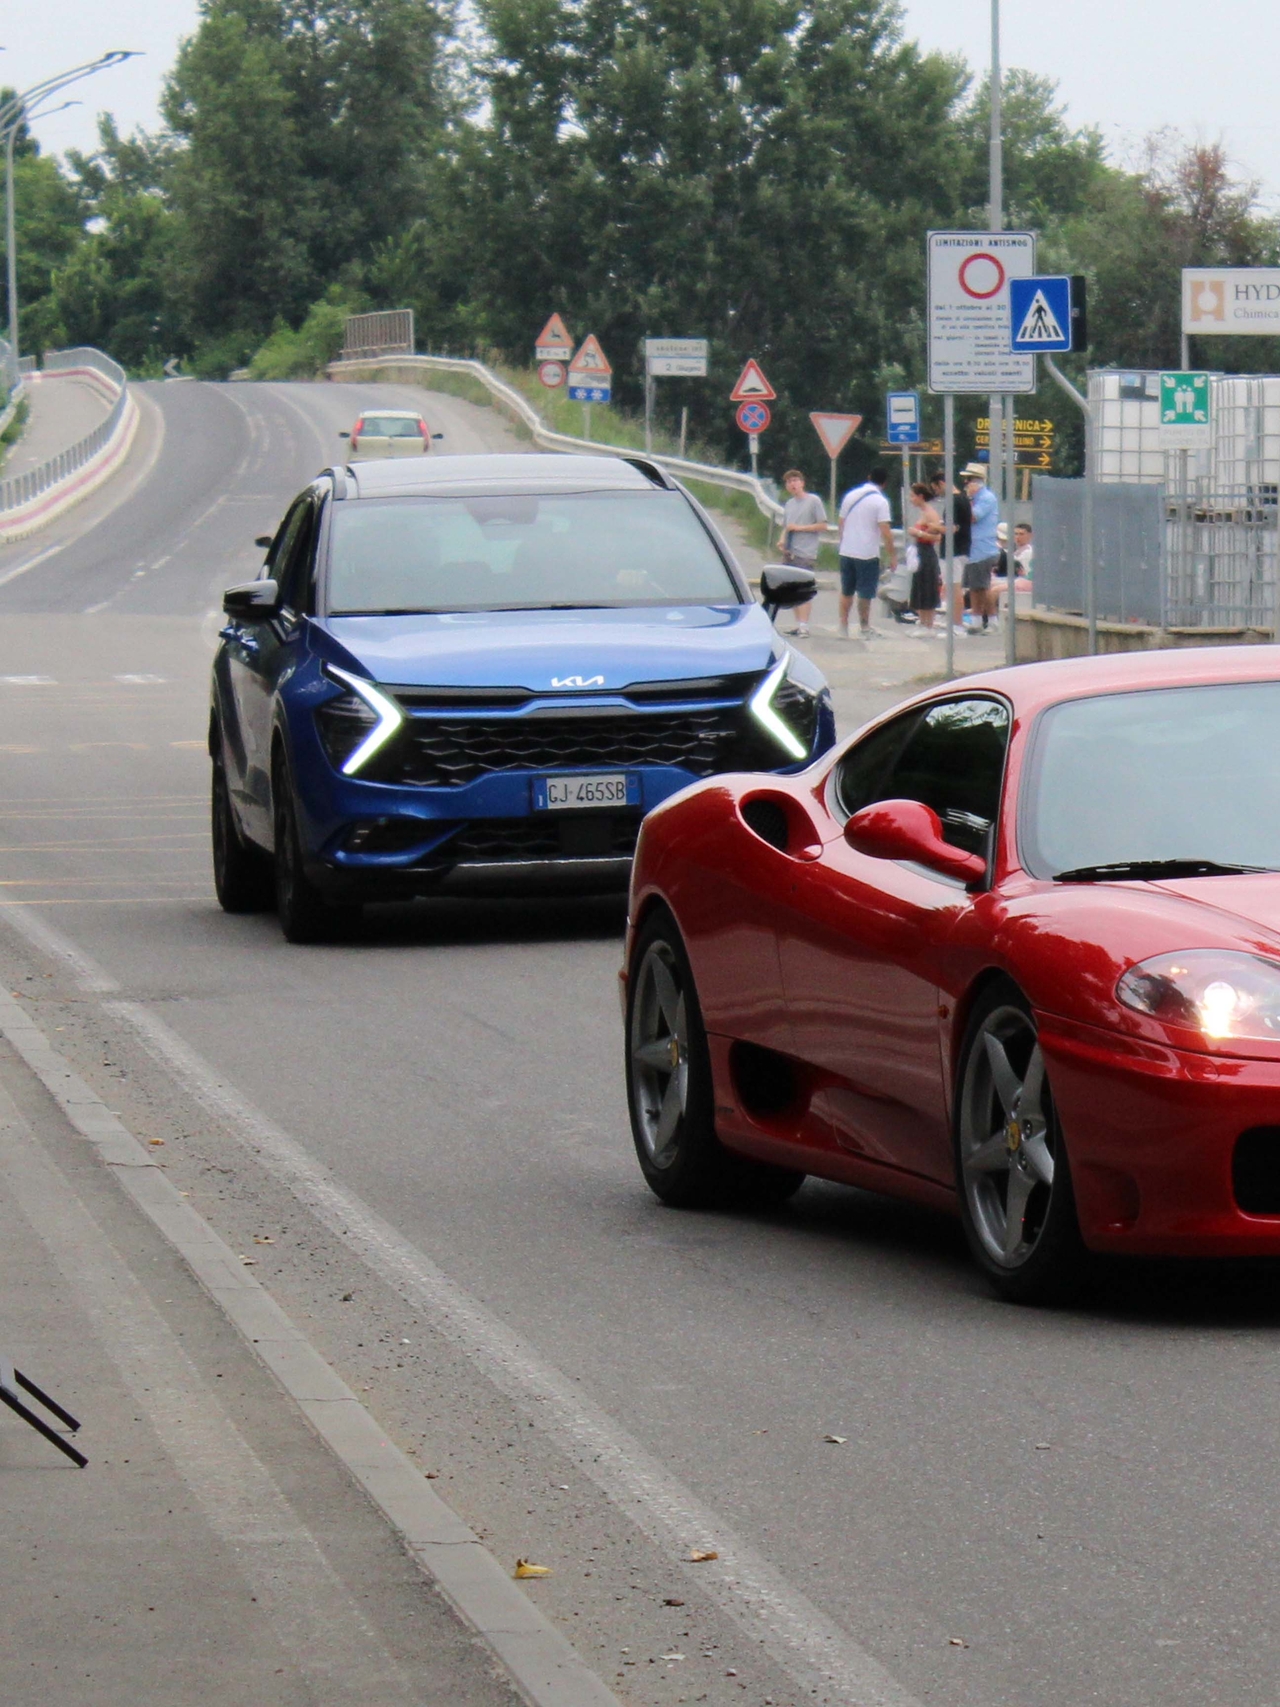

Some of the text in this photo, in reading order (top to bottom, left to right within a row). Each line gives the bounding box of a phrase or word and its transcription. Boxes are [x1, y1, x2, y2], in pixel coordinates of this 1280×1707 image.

[935, 239, 1029, 247] LIMITAZIONI ANTISMOG
[1233, 307, 1280, 319] Chimica
[551, 675, 605, 687] KIA
